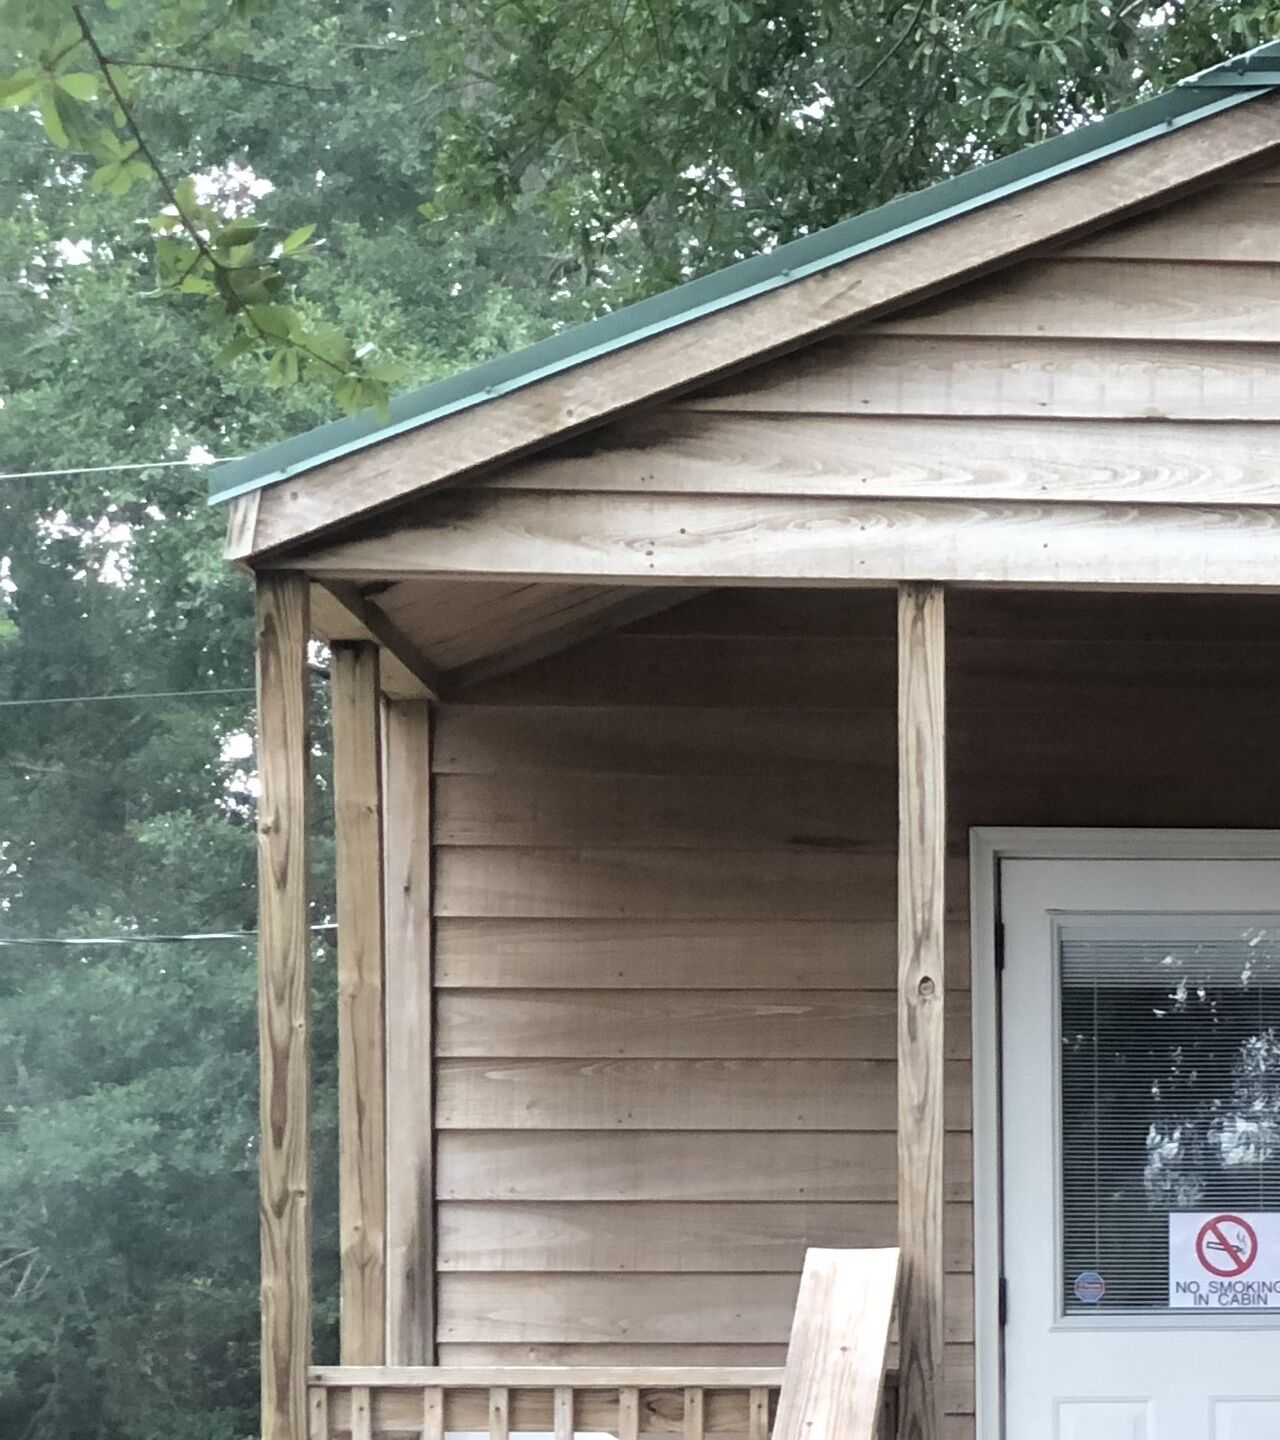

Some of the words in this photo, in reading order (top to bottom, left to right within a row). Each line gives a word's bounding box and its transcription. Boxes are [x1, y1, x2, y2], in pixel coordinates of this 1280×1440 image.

[1175, 1280, 1200, 1294] NO
[1193, 1293, 1209, 1306] IN
[1217, 1293, 1268, 1306] CABIN
